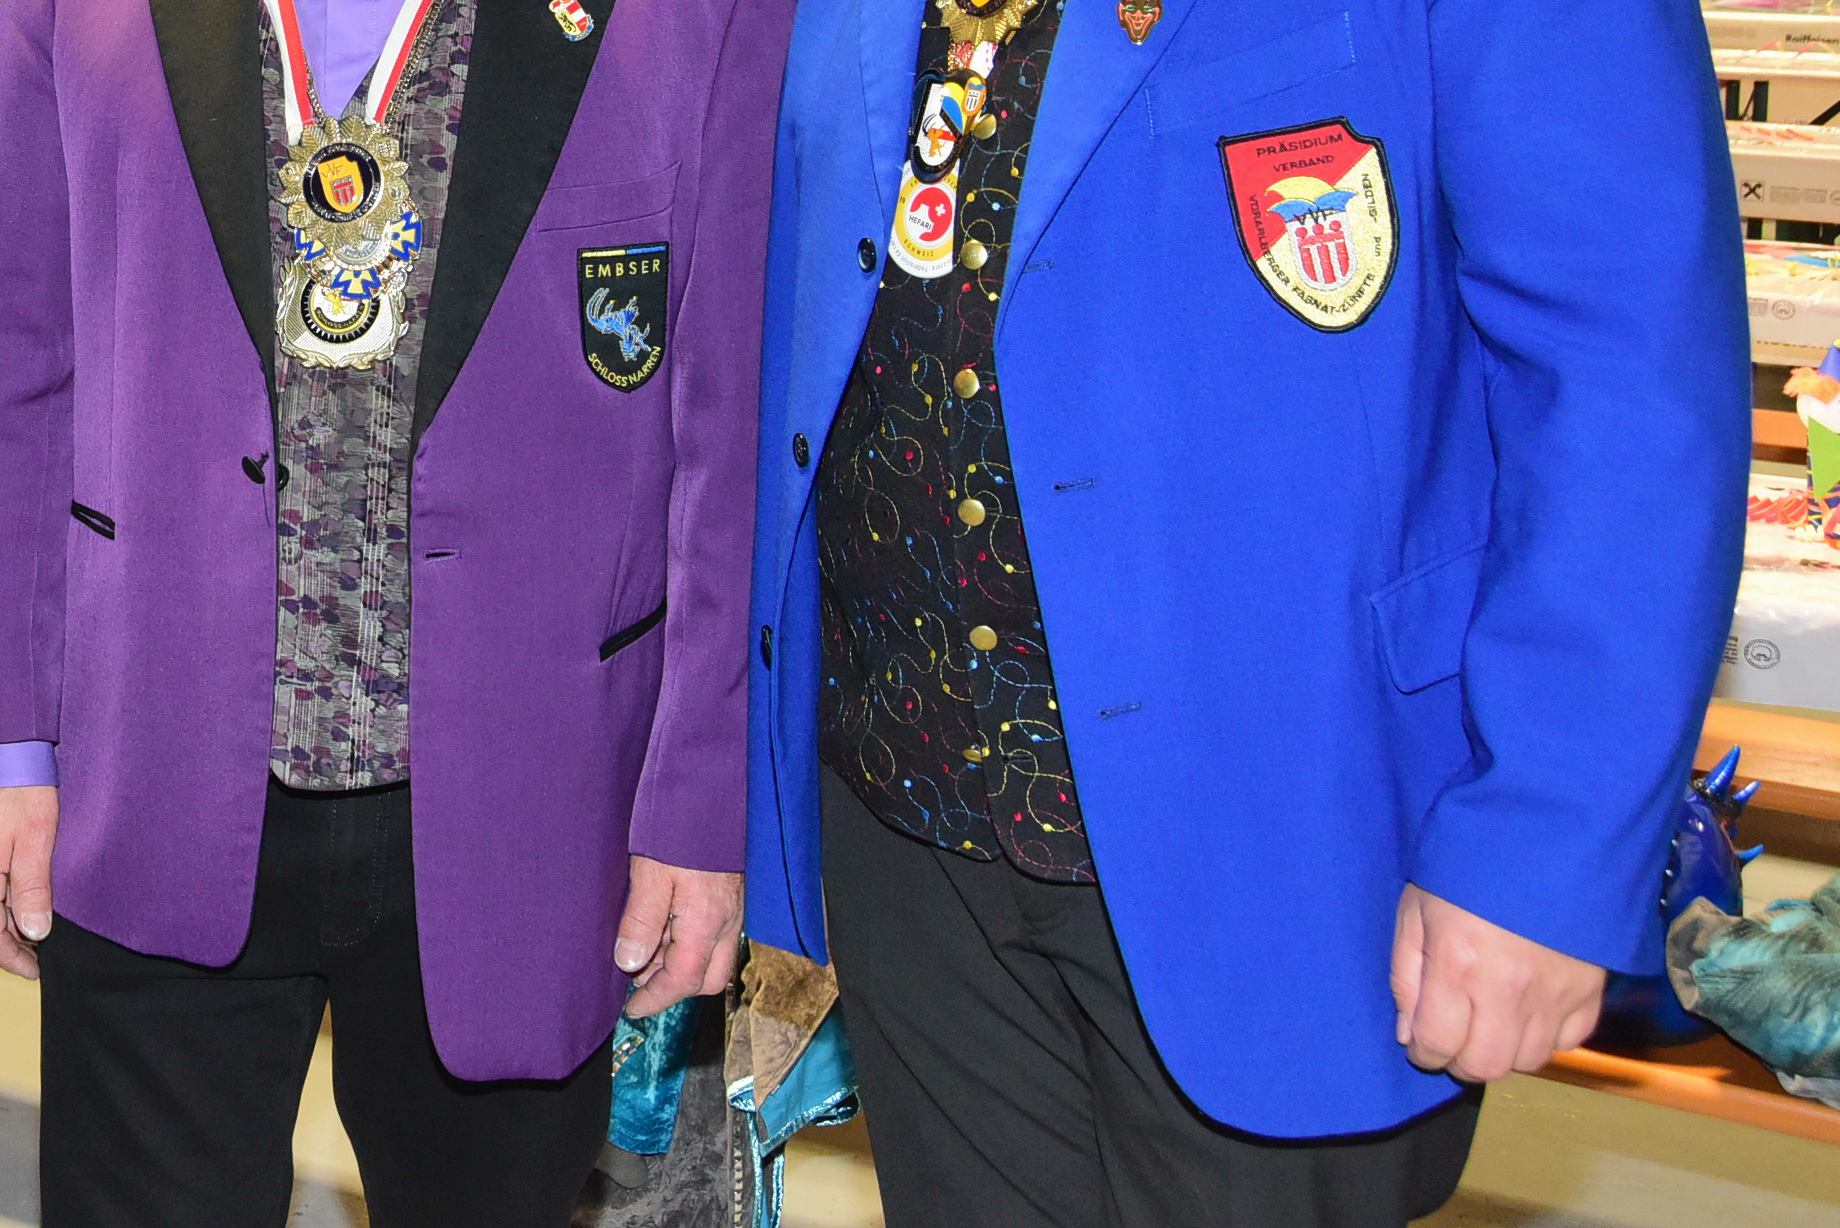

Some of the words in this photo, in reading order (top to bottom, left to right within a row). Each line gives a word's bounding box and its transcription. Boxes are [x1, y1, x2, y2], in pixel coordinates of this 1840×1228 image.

[1256, 133, 1343, 157] PRÄSIDIUM
[1273, 154, 1335, 172] VERBAND
[908, 214, 932, 231] HEFARI
[903, 238, 934, 257] SCHWEIZ
[585, 258, 661, 279] EMBSER
